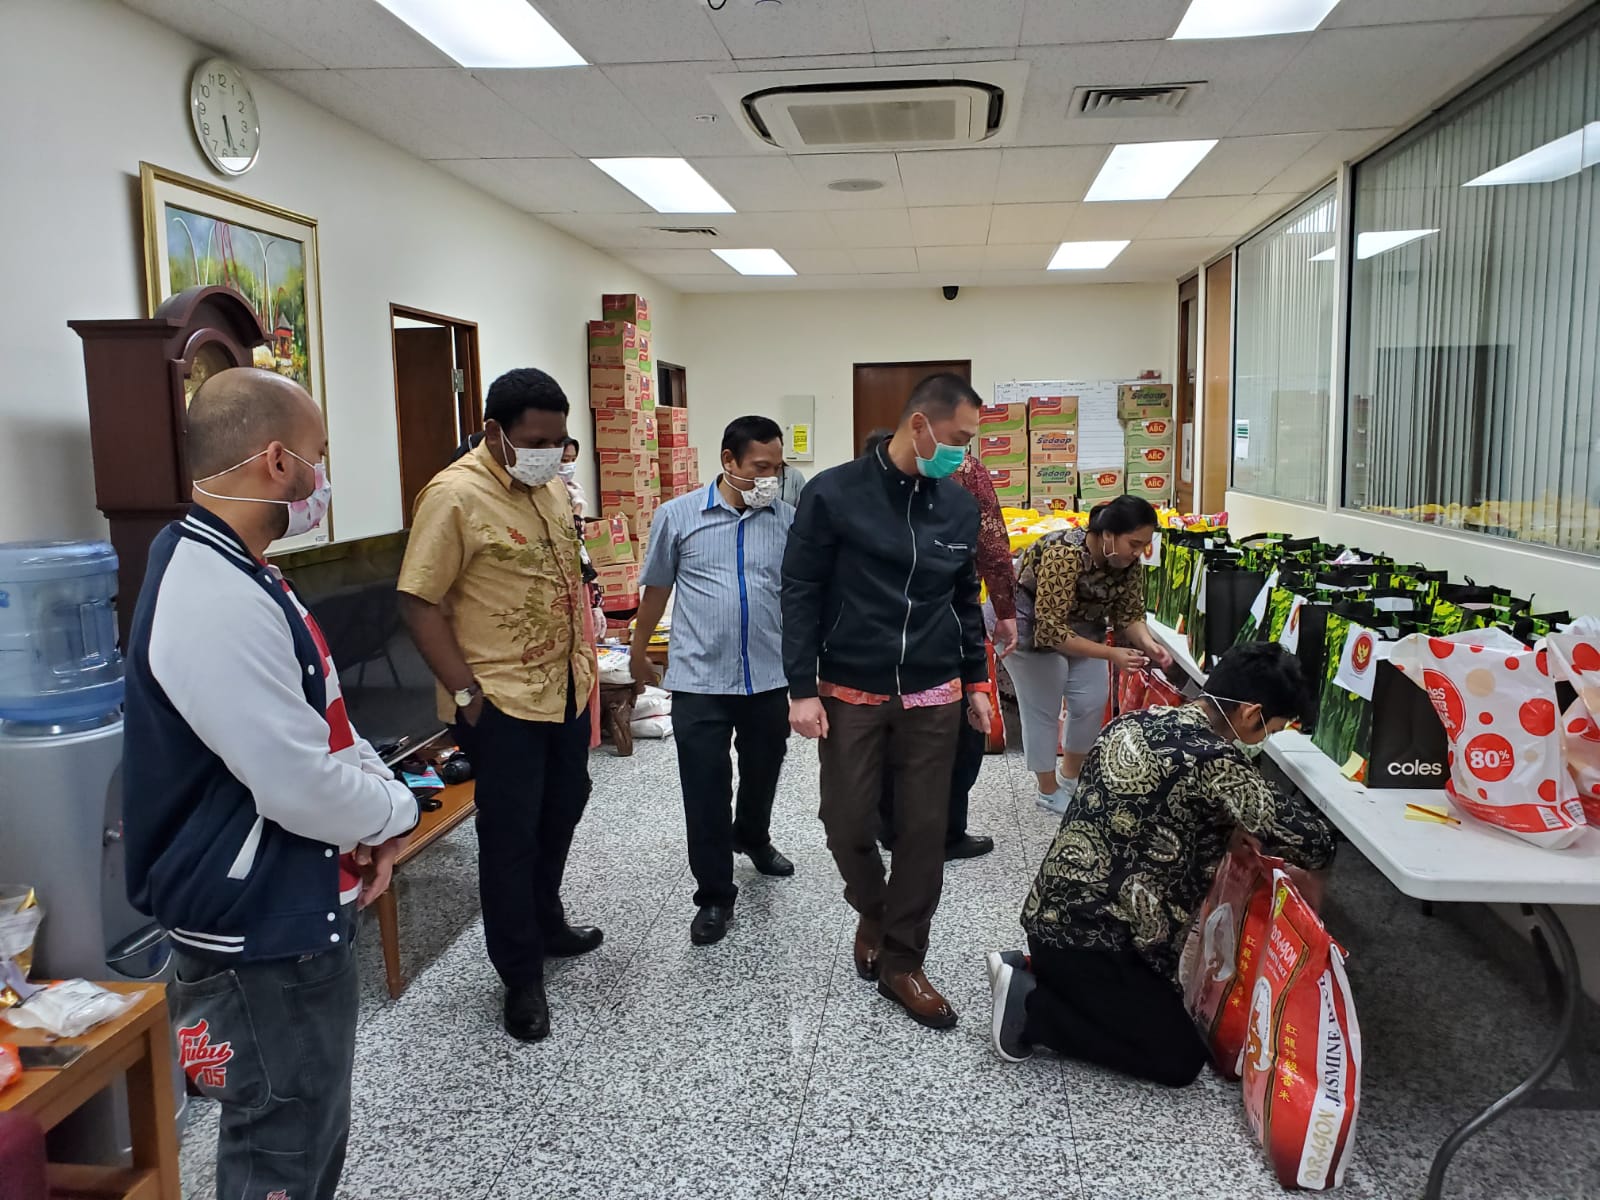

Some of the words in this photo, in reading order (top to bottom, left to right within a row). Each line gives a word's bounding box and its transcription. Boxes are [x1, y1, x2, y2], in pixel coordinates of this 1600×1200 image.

[208, 73, 215, 86] 11
[218, 73, 227, 88] 12
[238, 100, 245, 113] 2
[1470, 749, 1510, 768] 80%
[1387, 759, 1442, 775] coles
[1324, 1028, 1341, 1107] JASMINE
